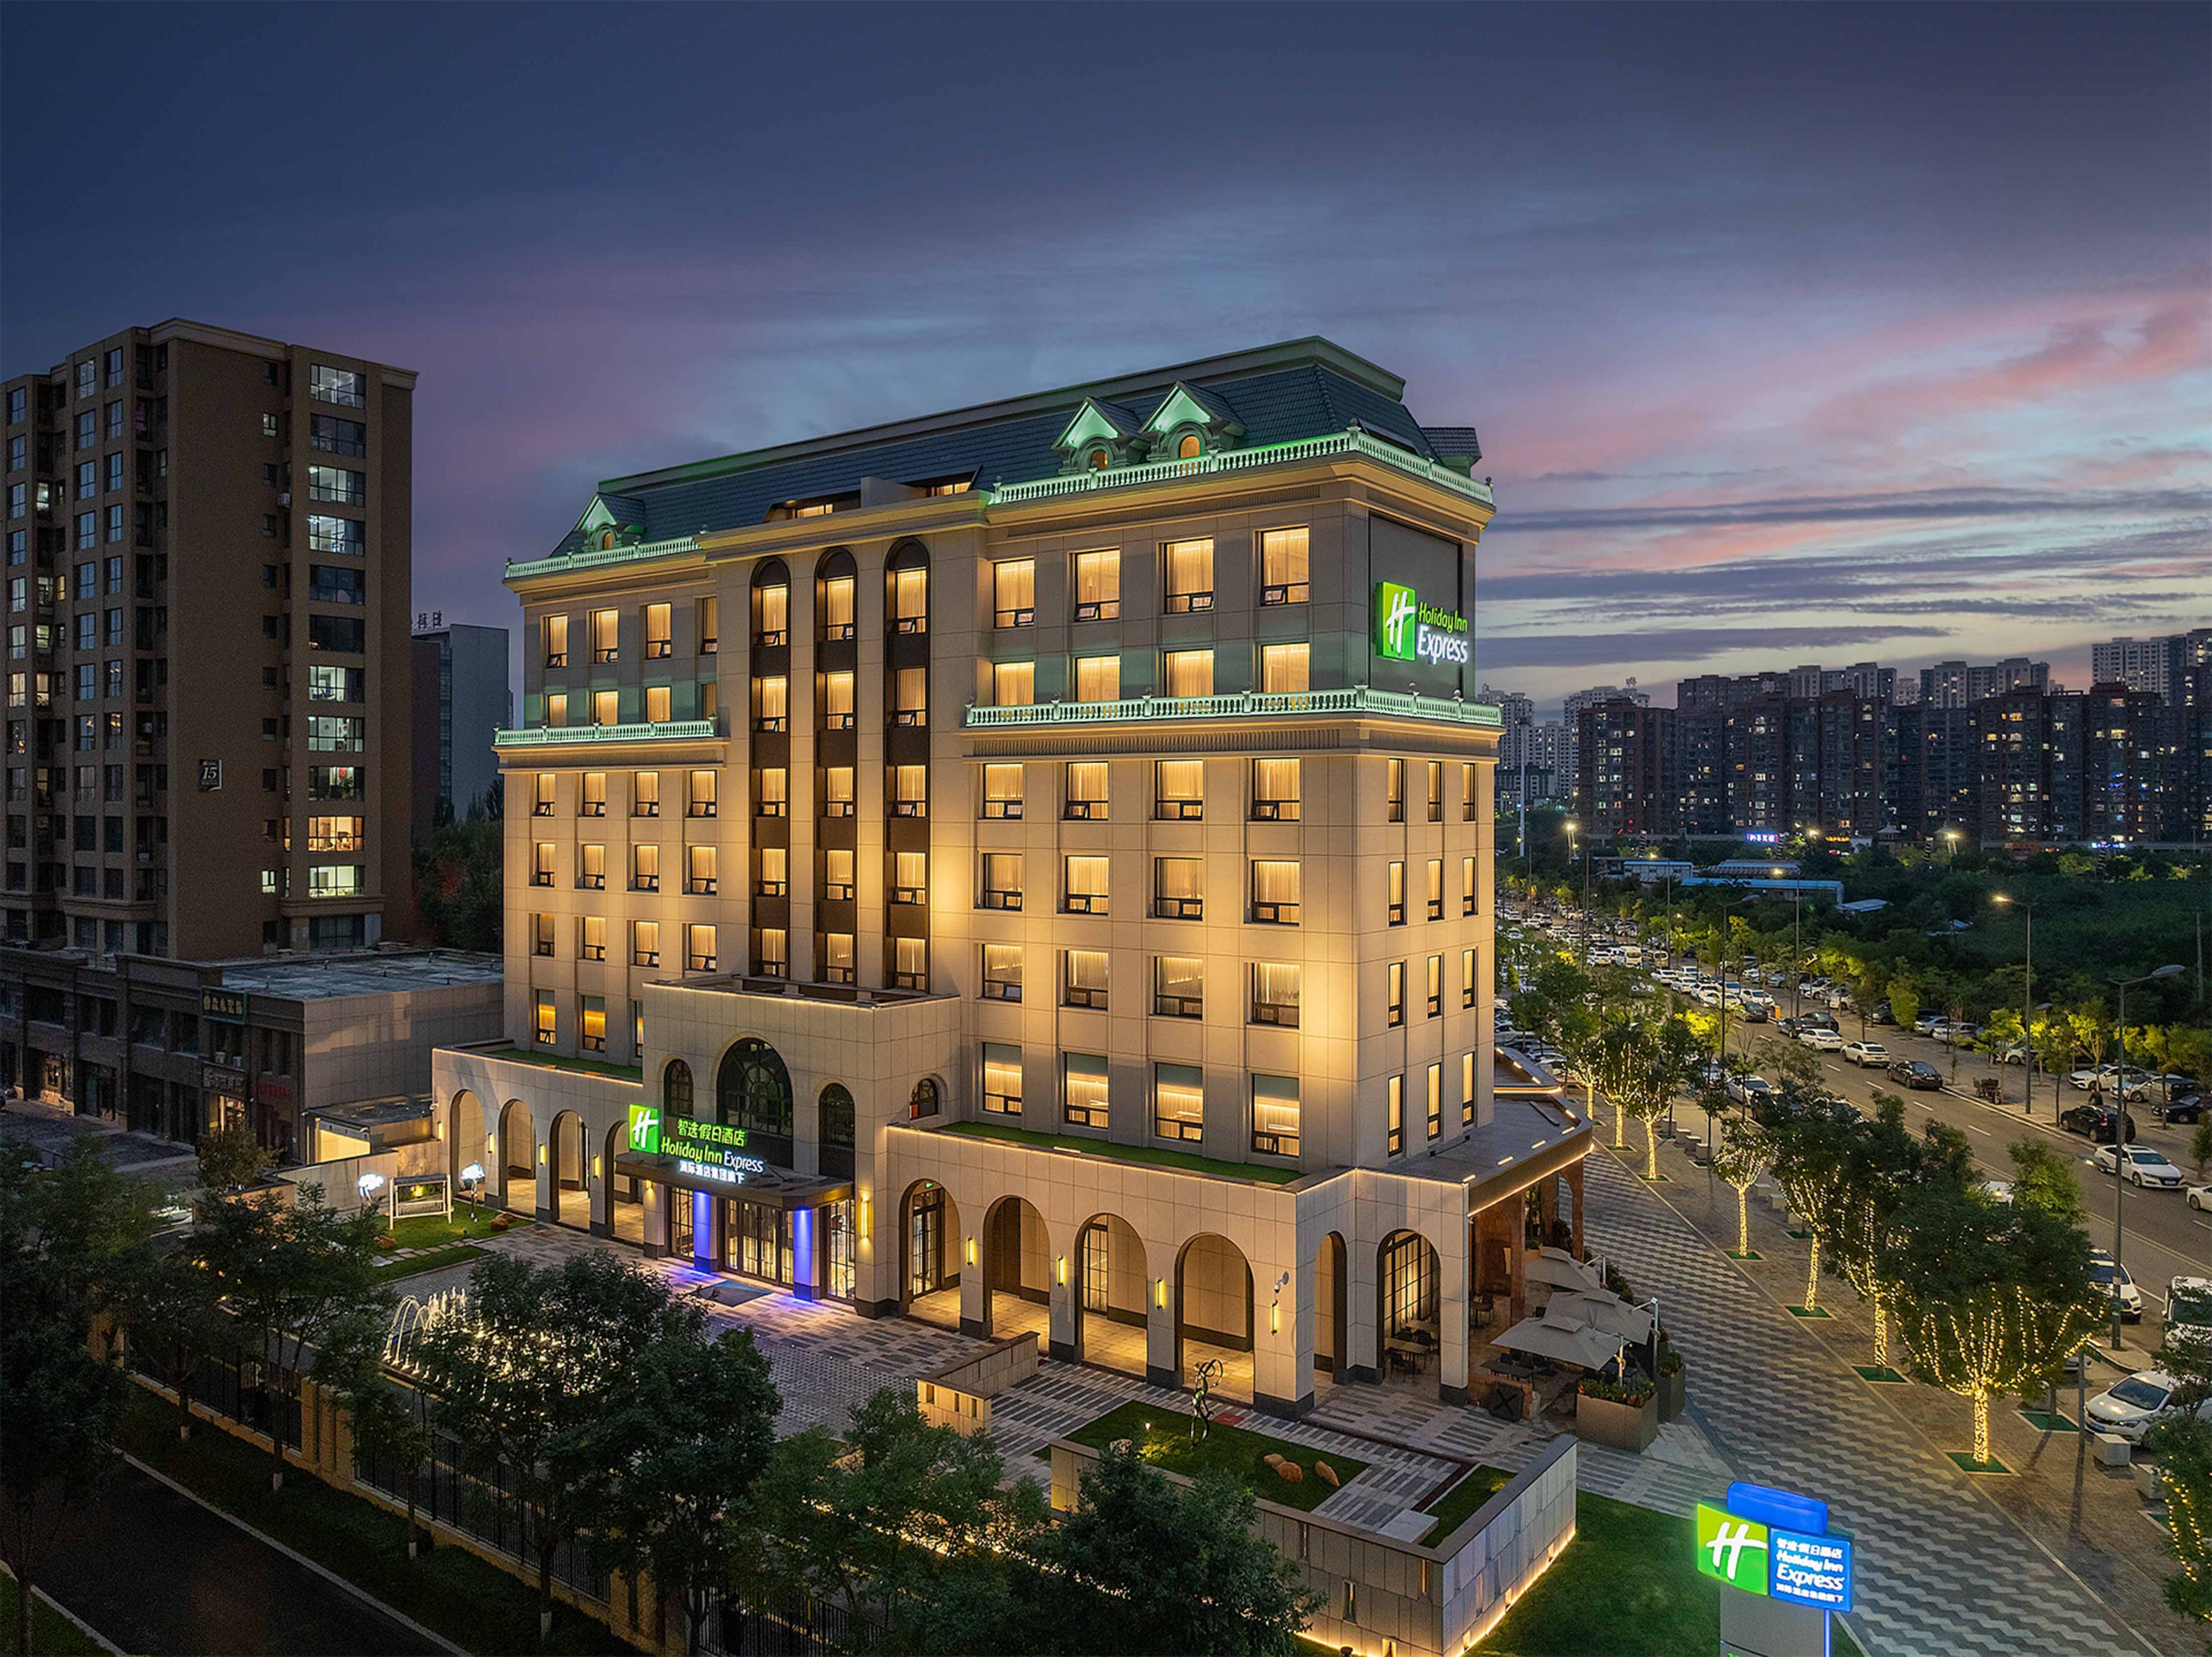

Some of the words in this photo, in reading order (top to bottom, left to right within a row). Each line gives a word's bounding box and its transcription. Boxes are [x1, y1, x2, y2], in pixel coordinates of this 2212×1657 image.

[1418, 602, 1454, 634] Holiday
[1454, 611, 1468, 632] Inn
[1417, 624, 1468, 665] Express
[202, 767, 217, 779] 15
[677, 1118, 745, 1147] 智选假日酒店
[661, 1136, 703, 1164] Holiday
[704, 1144, 723, 1164] Inn
[723, 1150, 764, 1173] Express
[1776, 1563, 1845, 1591] Express
[1823, 1558, 1844, 1572] Inn
